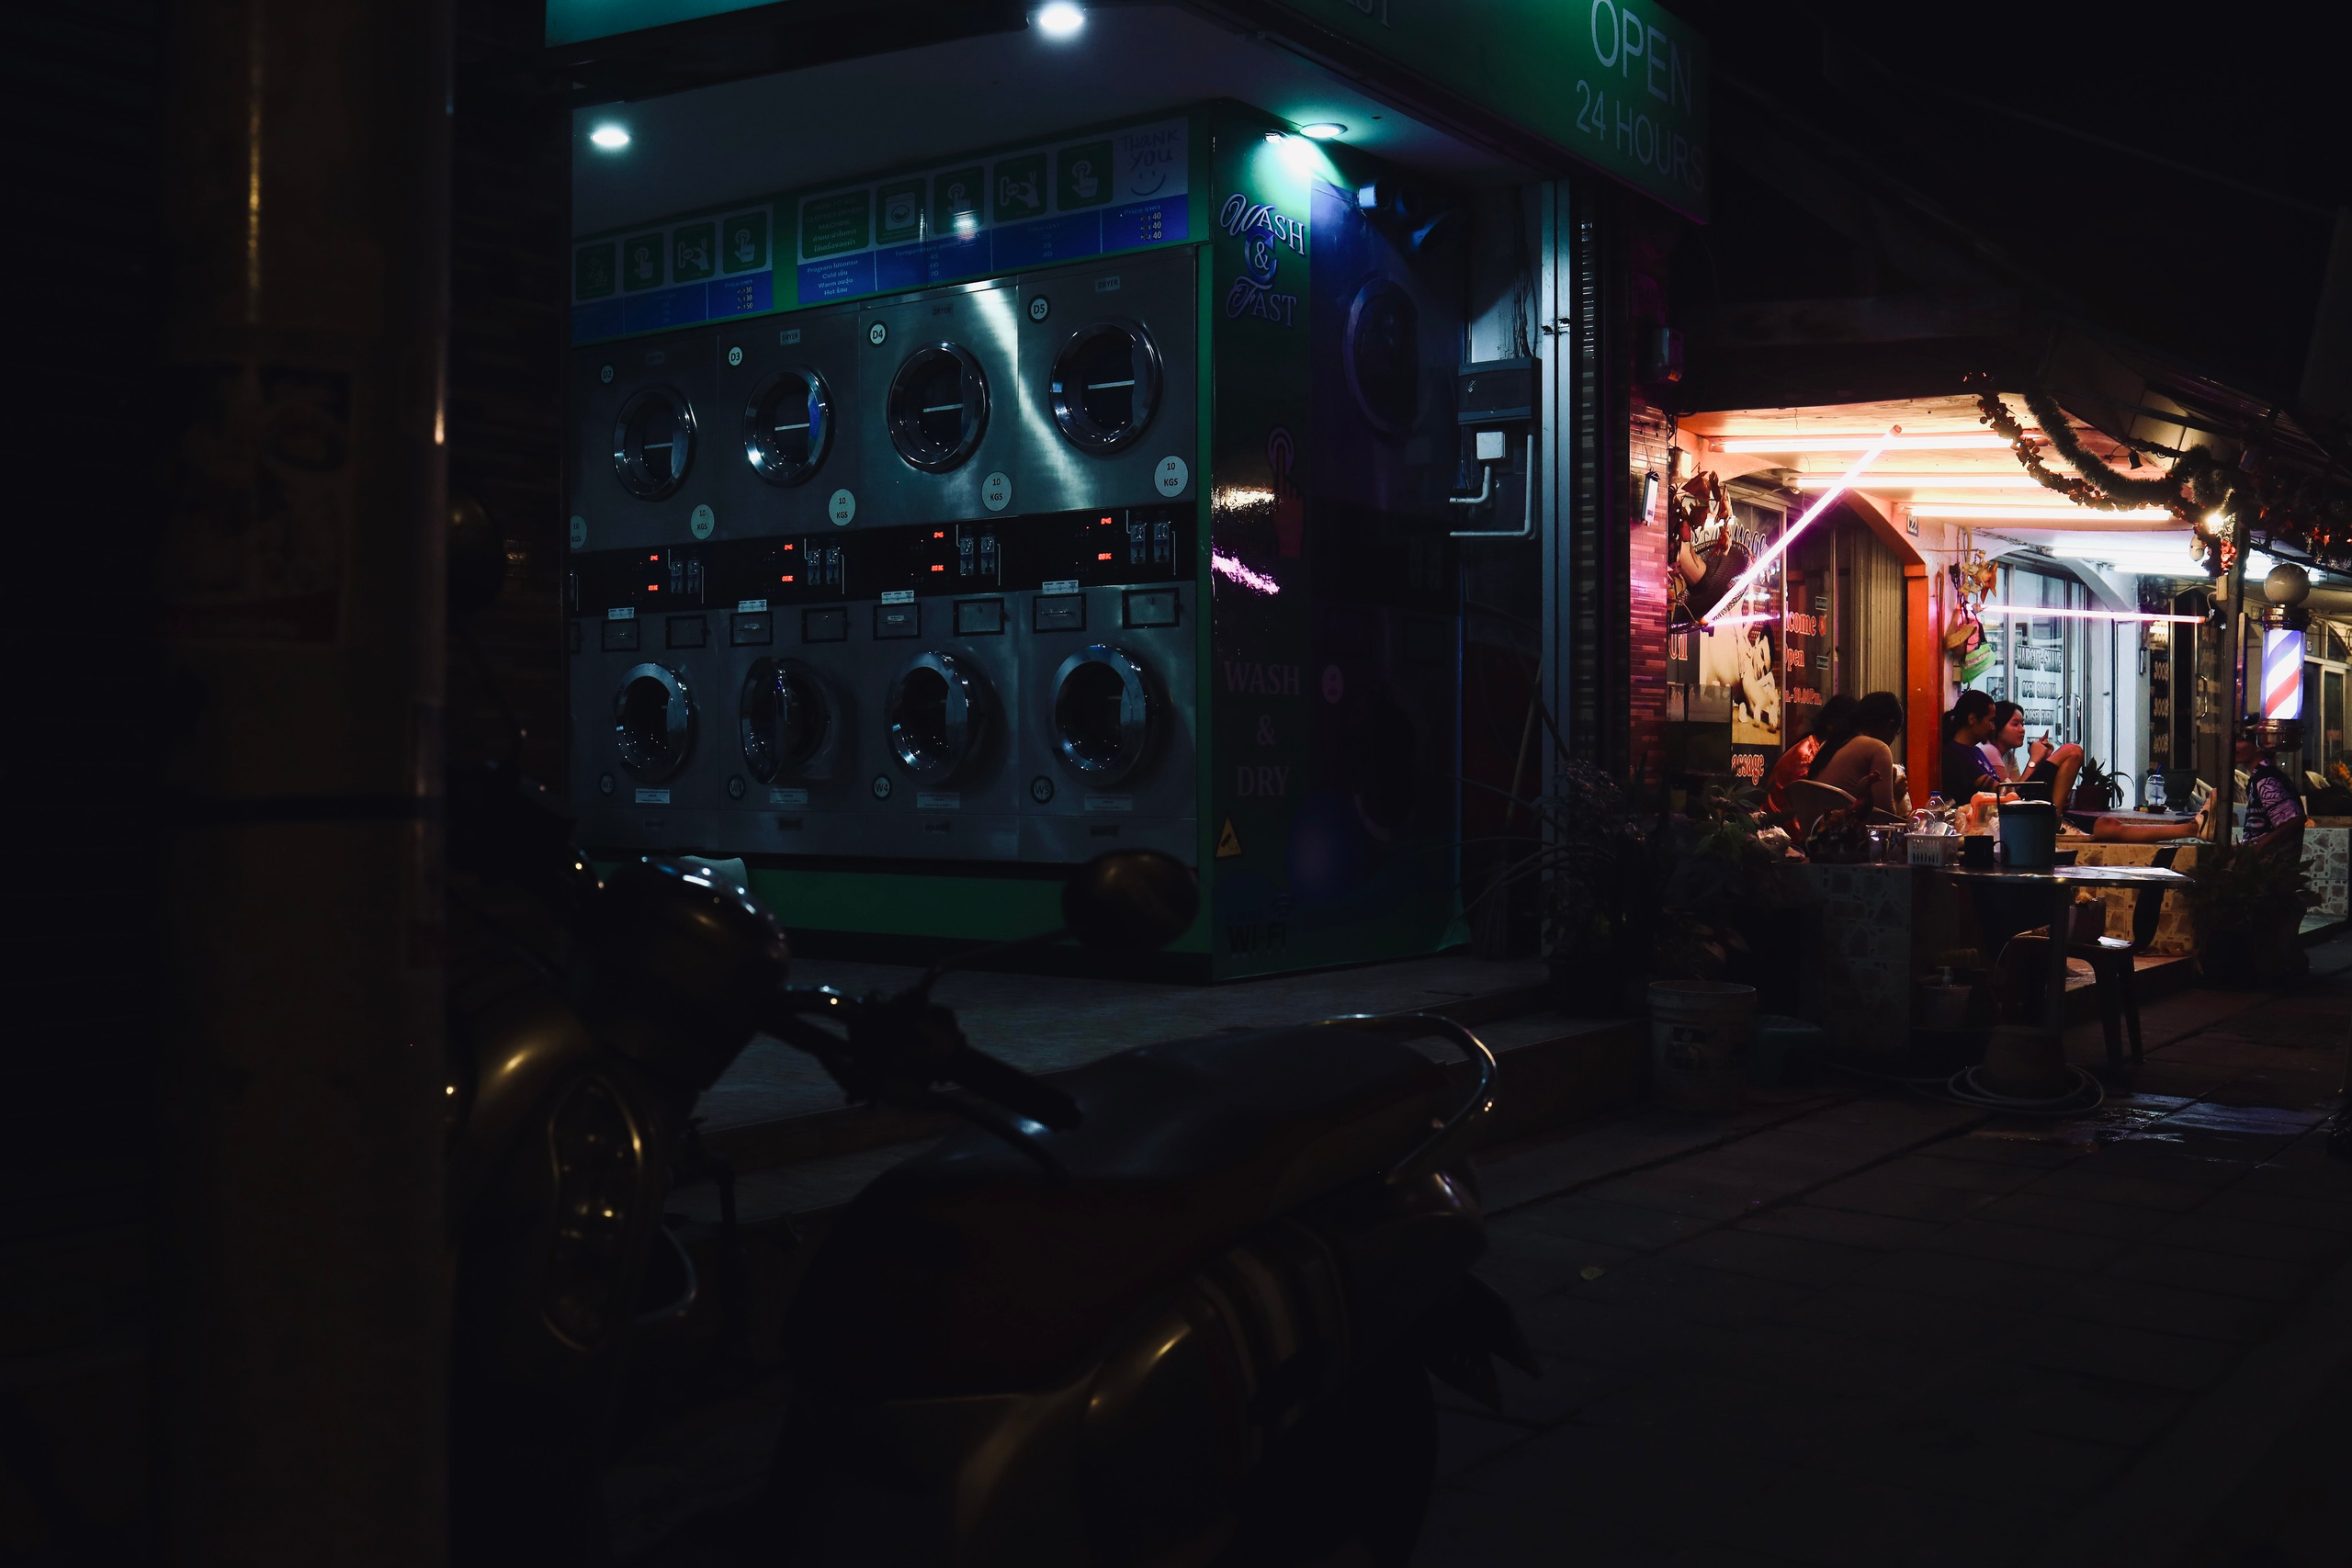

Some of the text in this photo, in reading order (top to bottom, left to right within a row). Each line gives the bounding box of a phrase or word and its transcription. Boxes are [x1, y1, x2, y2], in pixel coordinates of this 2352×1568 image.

[1590, 0, 1692, 117] OPEN
[1576, 79, 1706, 193] 24 HOURS
[1152, 211, 1162, 220] 40
[1152, 220, 1162, 230] 40
[1152, 231, 1162, 239] 40
[1255, 242, 1269, 270] &
[807, 265, 832, 274] Program
[1098, 279, 1118, 288] DRYER
[1034, 303, 1046, 314] D5
[872, 330, 883, 339] D4
[730, 352, 741, 361] D3
[603, 369, 611, 378] D2
[1167, 462, 1176, 470] 10
[1164, 478, 1178, 487] KGS
[1785, 602, 1817, 637] lcome
[1224, 660, 1301, 695] WASH
[1256, 715, 1277, 746] &
[1731, 753, 1765, 786] assage
[1237, 766, 1290, 796] DRY
[875, 783, 888, 792] W4
[1035, 784, 1050, 795] W5
